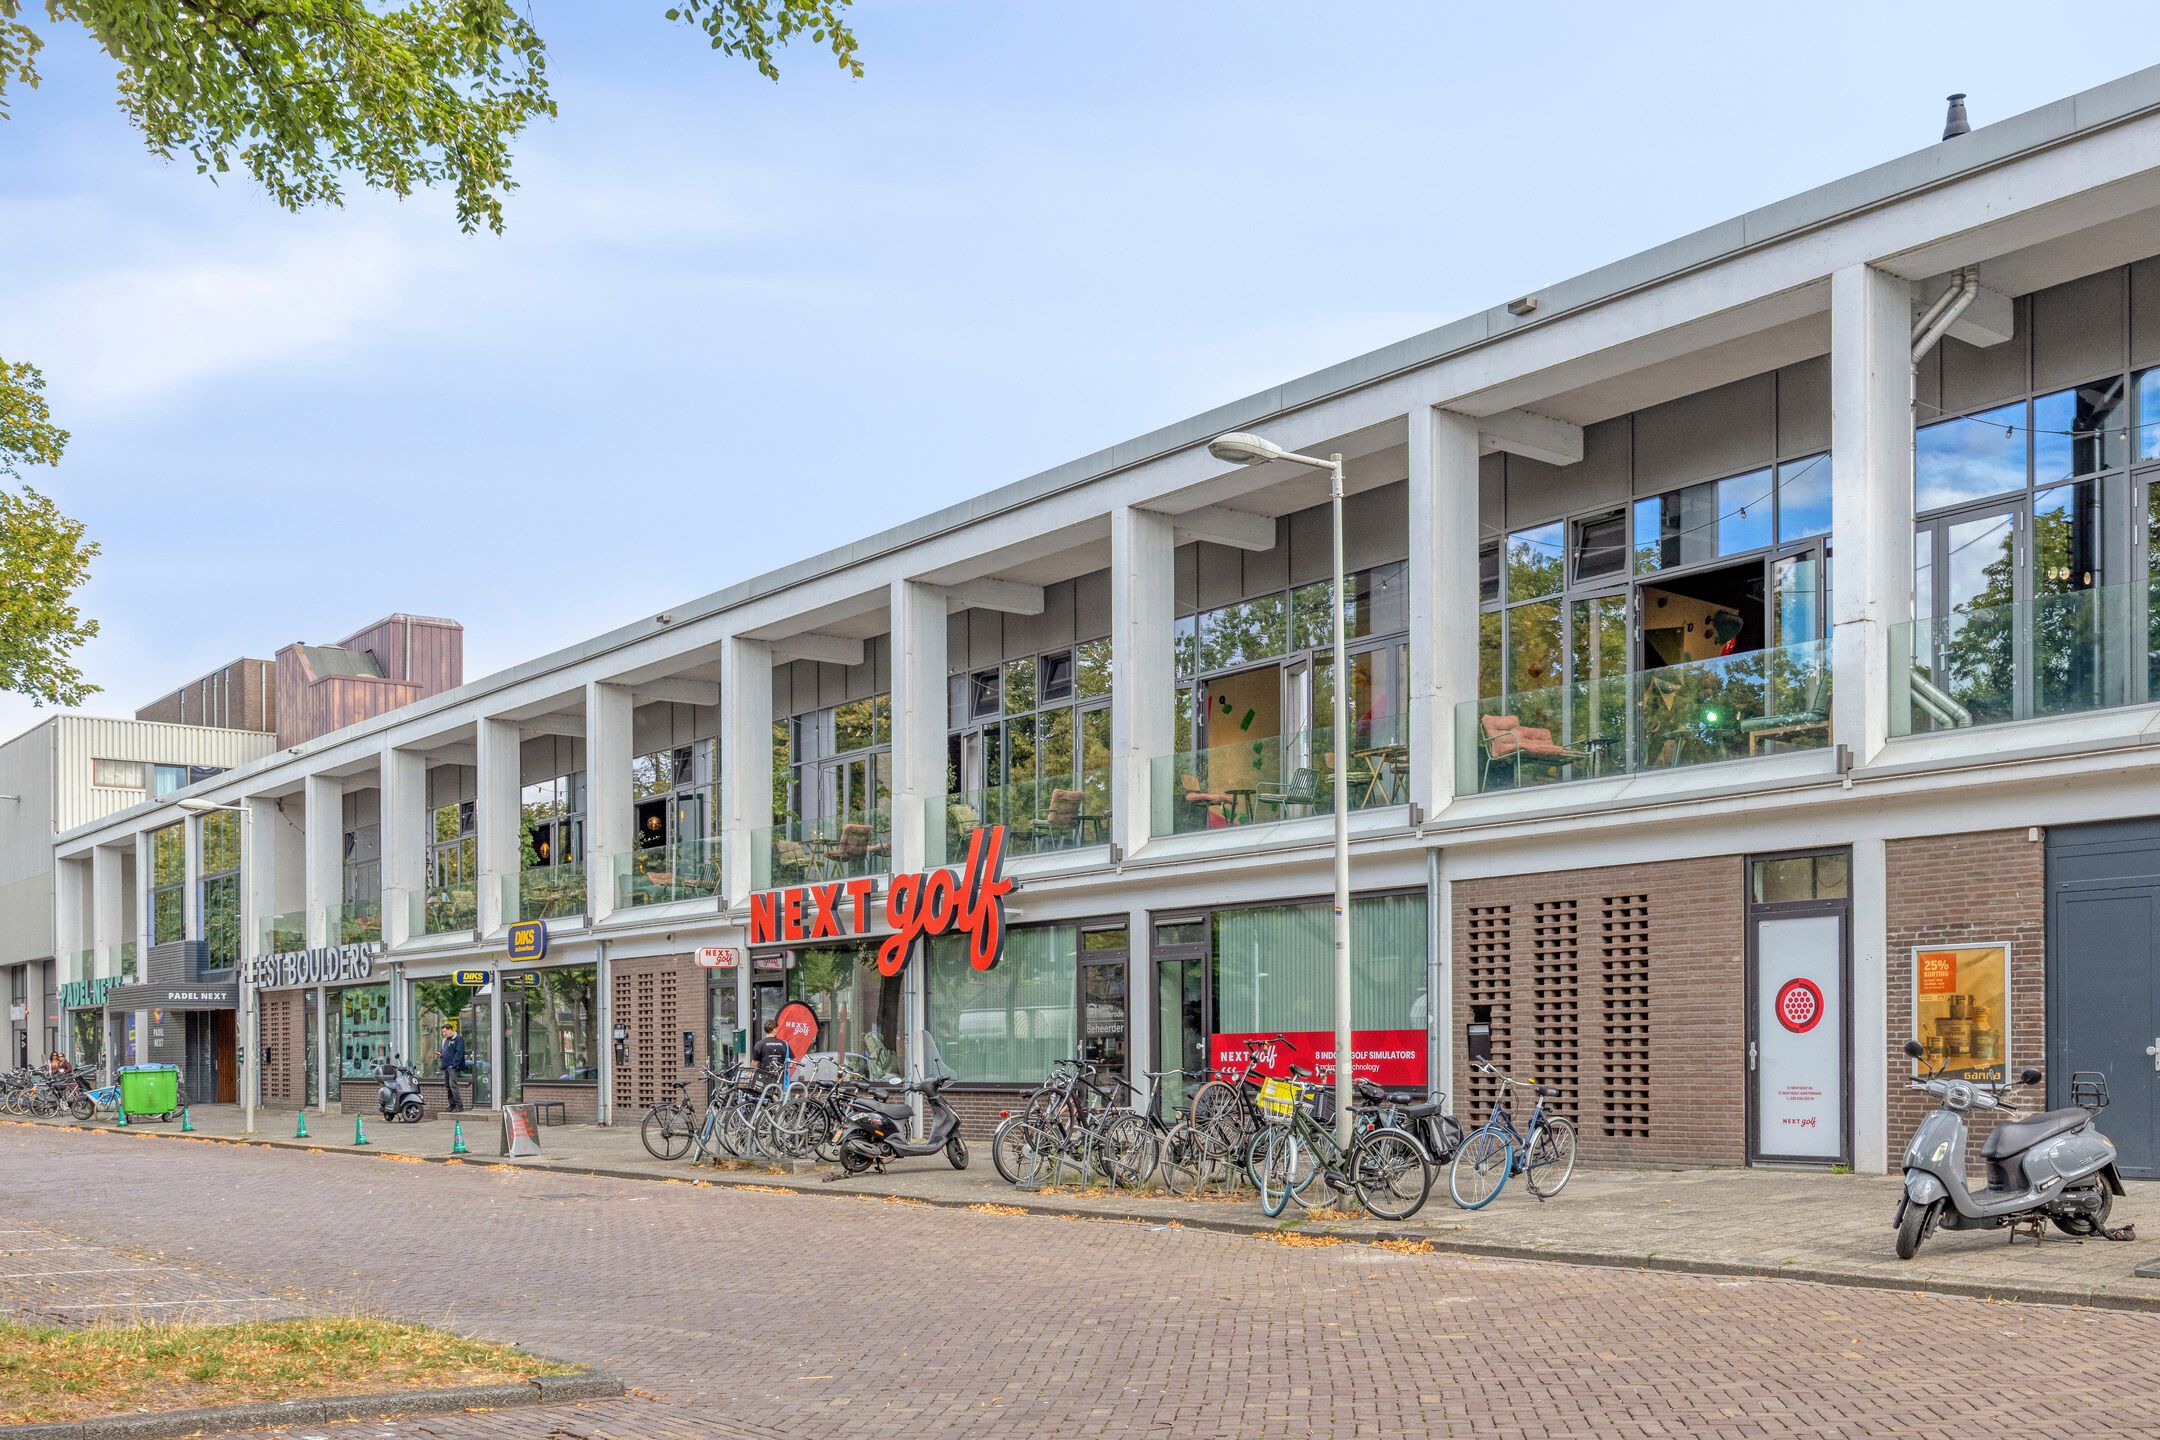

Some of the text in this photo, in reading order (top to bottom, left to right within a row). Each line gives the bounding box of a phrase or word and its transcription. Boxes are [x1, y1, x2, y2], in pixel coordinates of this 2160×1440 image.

[751, 825, 1019, 977] NEXT golf
[514, 929, 535, 945] DIKS
[286, 942, 372, 985] BOULDERS
[716, 953, 733, 965] golf
[1924, 959, 1949, 971] 25%
[60, 979, 91, 1008] PADEL
[168, 992, 227, 1000] PADEL NEXT
[785, 1021, 807, 1029] NEXT
[1087, 1022, 1124, 1033] Beheerder
[1220, 1051, 1250, 1062] NEXT
[1315, 1051, 1320, 1059] 8
[1350, 1051, 1368, 1059] GOLF
[1369, 1050, 1416, 1060] SIMULATORS
[1801, 1117, 1818, 1128] golf
